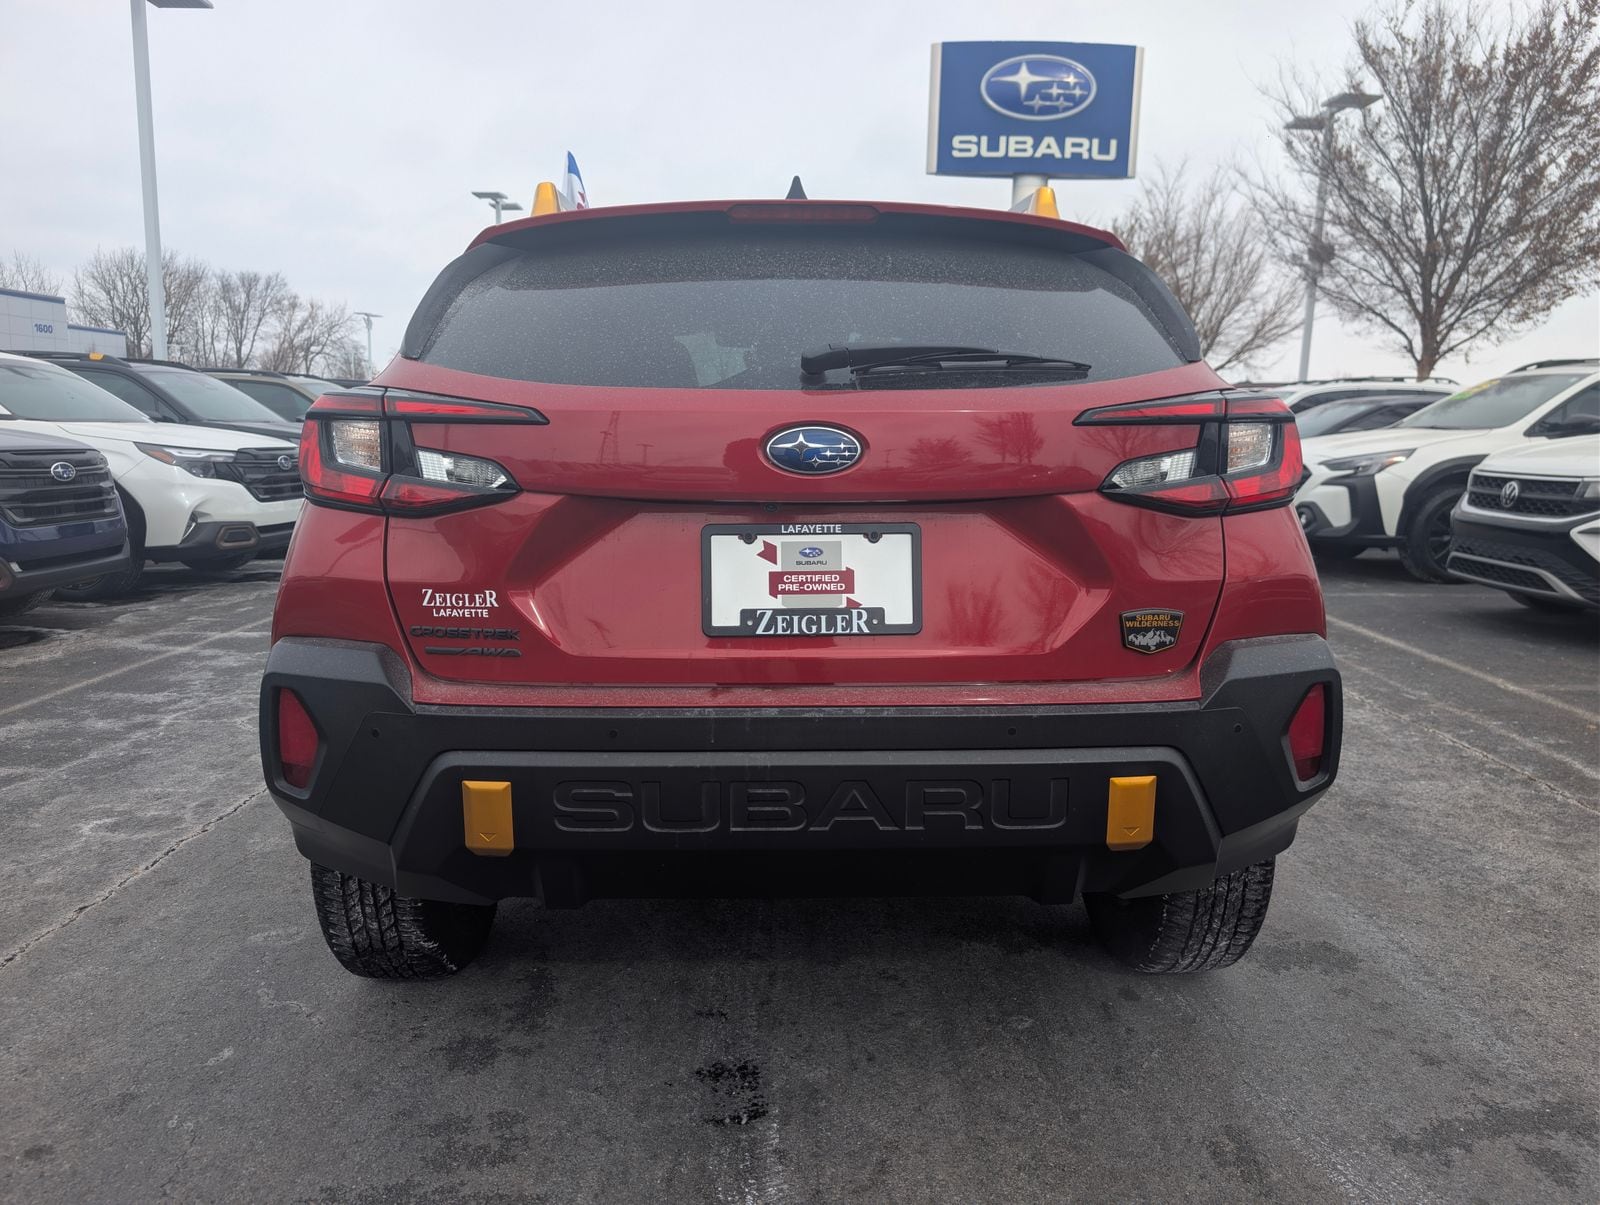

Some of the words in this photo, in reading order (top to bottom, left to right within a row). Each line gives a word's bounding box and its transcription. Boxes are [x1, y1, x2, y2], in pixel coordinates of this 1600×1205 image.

[951, 135, 1118, 161] SUBARU
[34, 323, 53, 334] 1600
[781, 524, 842, 534] LAFAYETTE
[783, 574, 840, 582] CERTIFIED
[778, 583, 846, 591] PRE-OWNED
[422, 588, 499, 608] ZEIGLER
[433, 608, 489, 617] LAFAYETTE
[755, 609, 870, 635] ZEIGLER
[410, 626, 520, 640] CROSSTREK
[553, 778, 1069, 832] SUBARU
